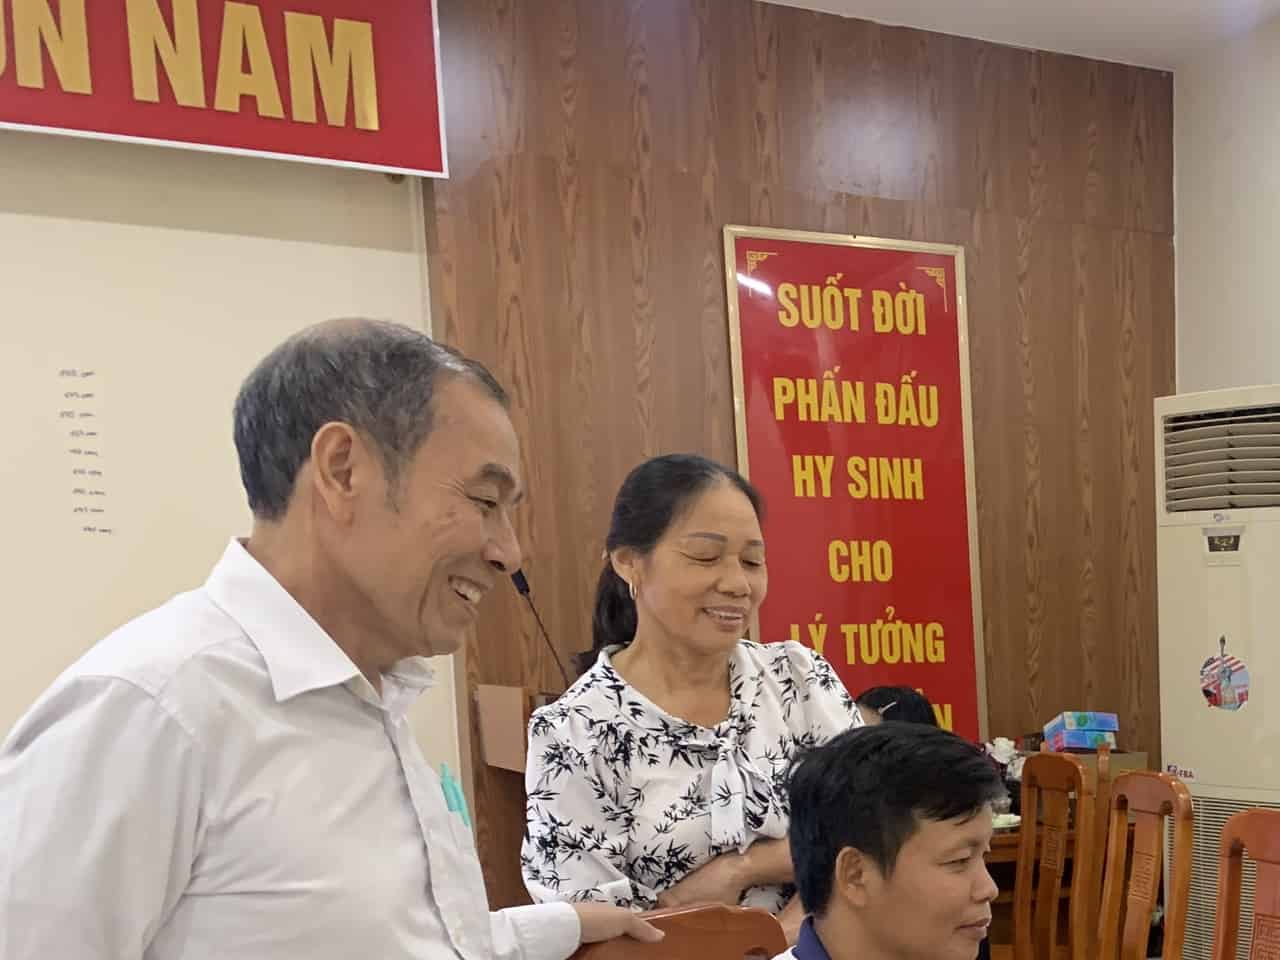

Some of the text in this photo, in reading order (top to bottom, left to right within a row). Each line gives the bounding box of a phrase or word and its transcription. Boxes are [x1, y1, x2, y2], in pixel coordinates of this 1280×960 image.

[777, 272, 926, 336] SUỐT ĐỜI
[773, 366, 939, 427] PHẤN ĐẤU
[792, 454, 925, 500] HY SINH
[828, 539, 893, 583] CHO
[840, 606, 945, 665] TƯỞNG
